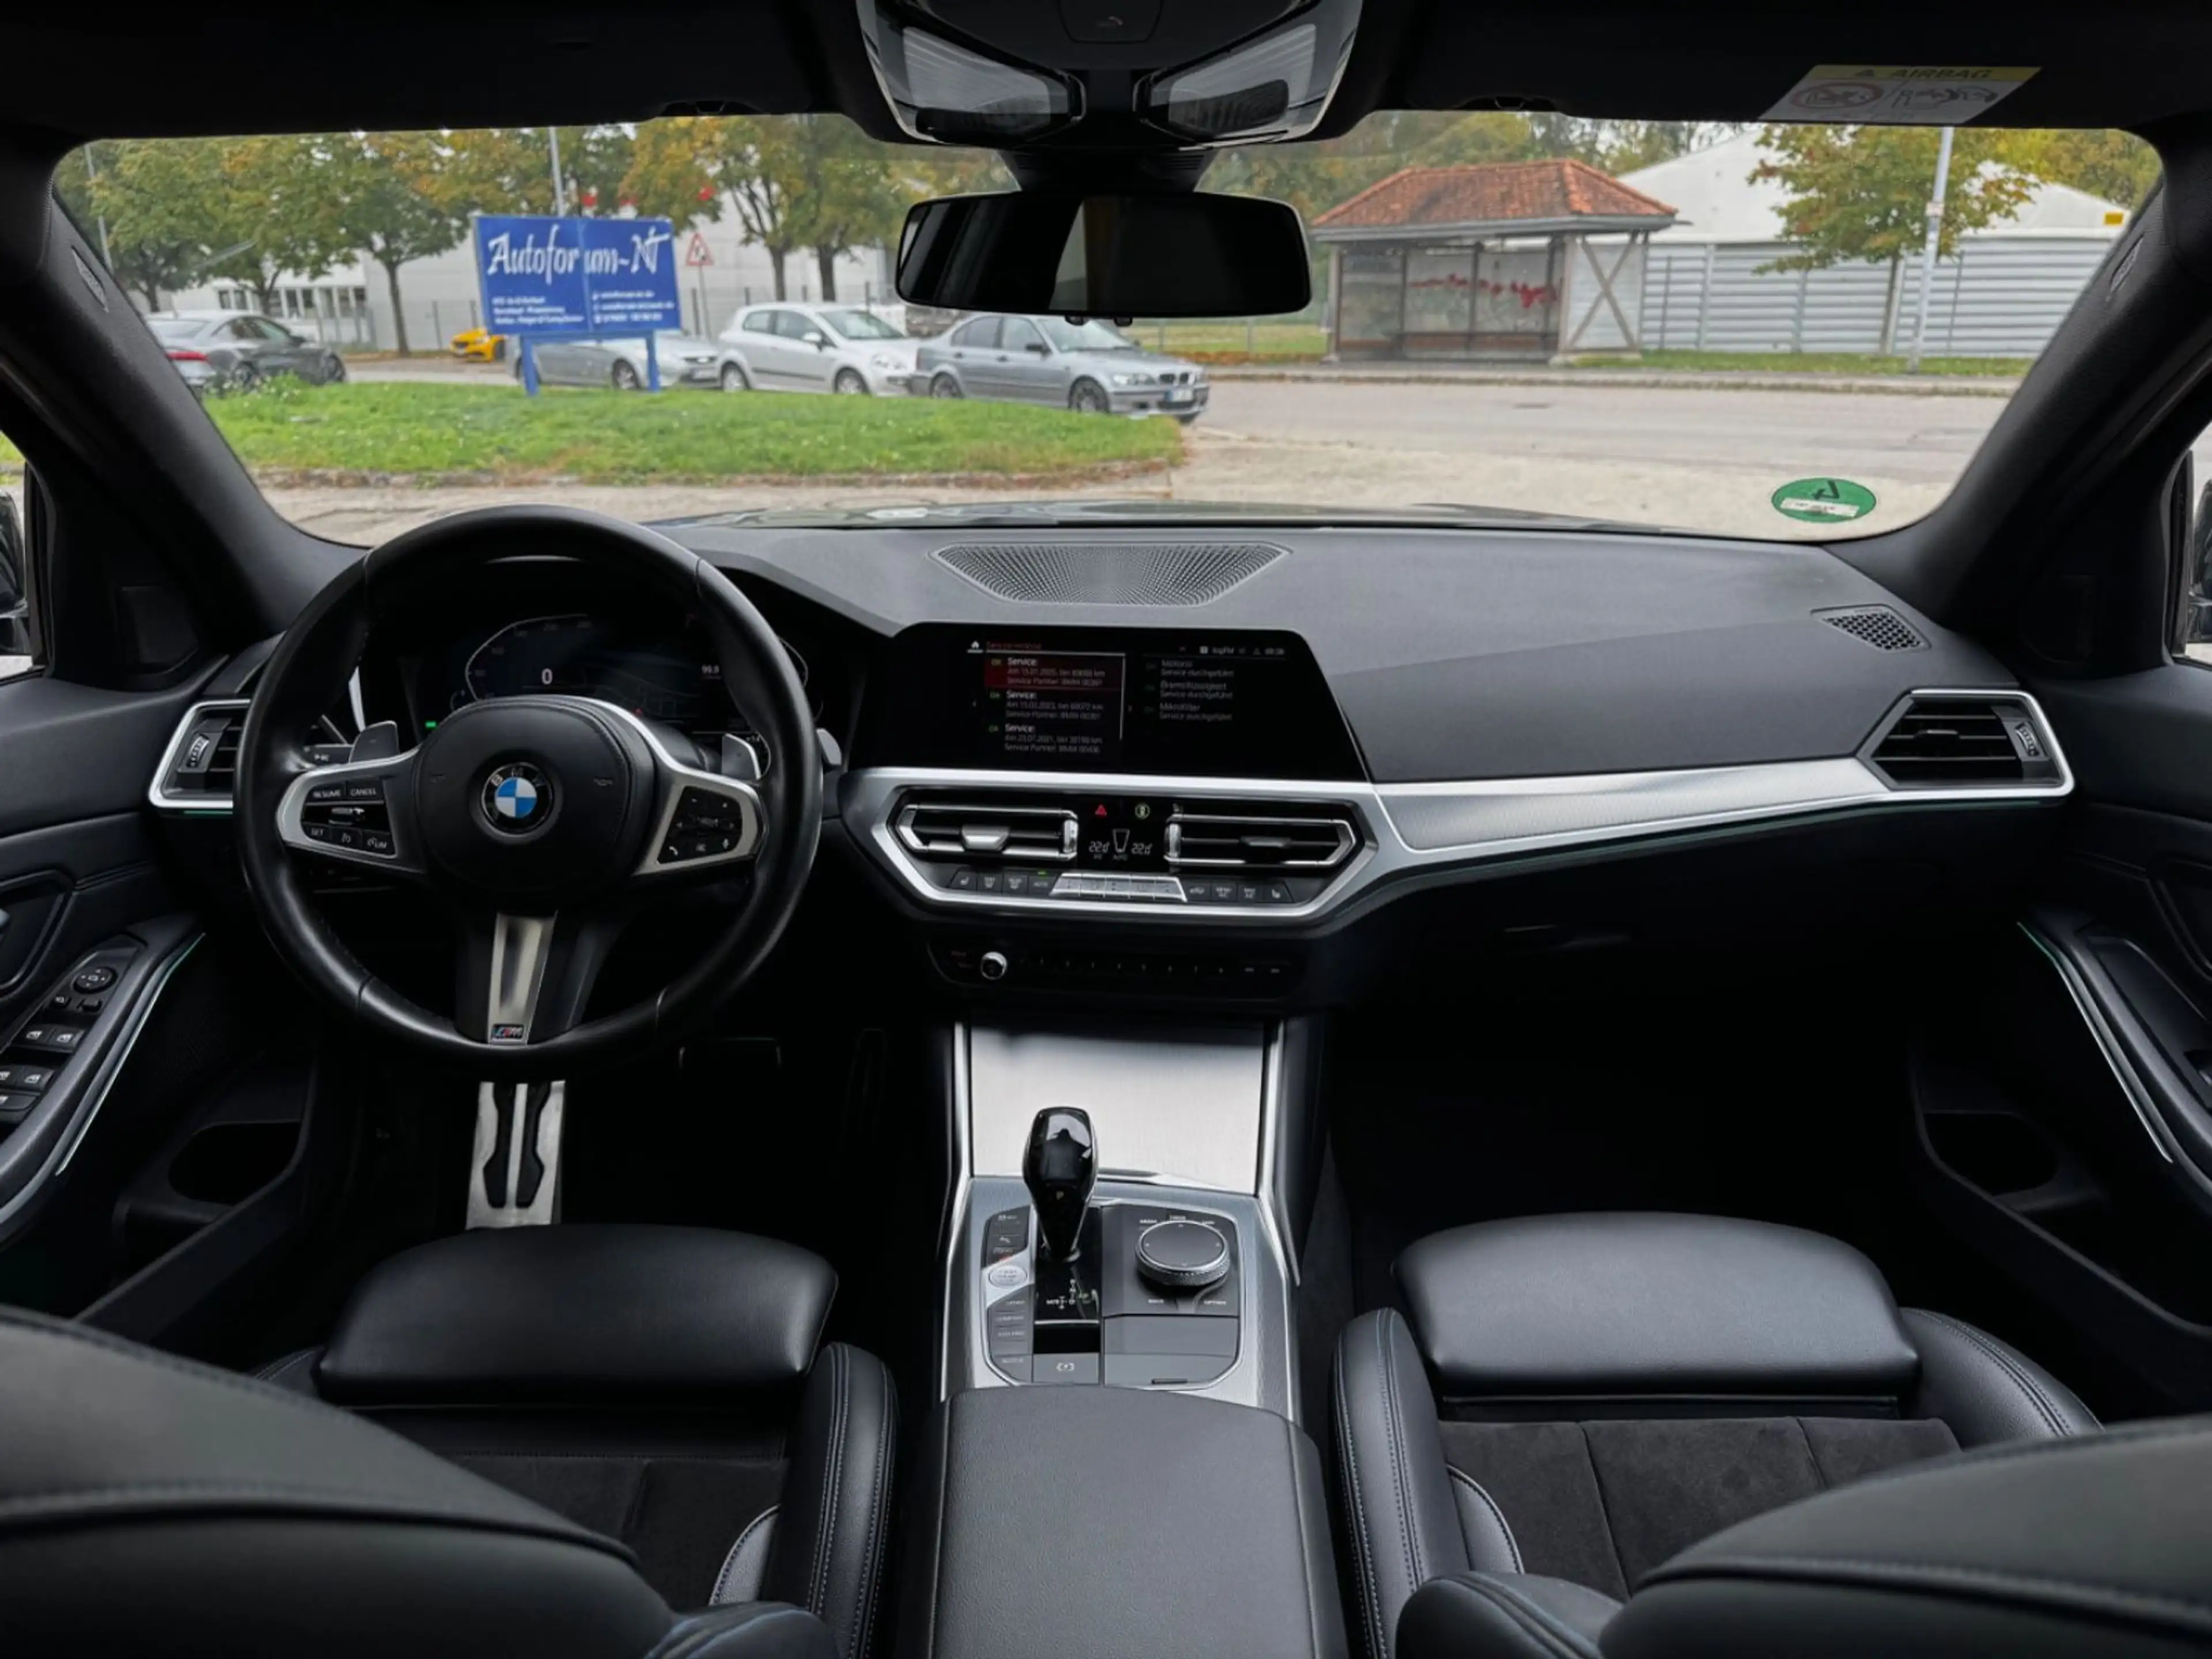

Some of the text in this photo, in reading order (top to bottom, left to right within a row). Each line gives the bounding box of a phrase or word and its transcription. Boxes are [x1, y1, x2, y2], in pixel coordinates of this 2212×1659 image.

[1889, 68, 1993, 79] AIRBAG
[541, 668, 553, 684] 0
[349, 787, 377, 797] CANCEL
